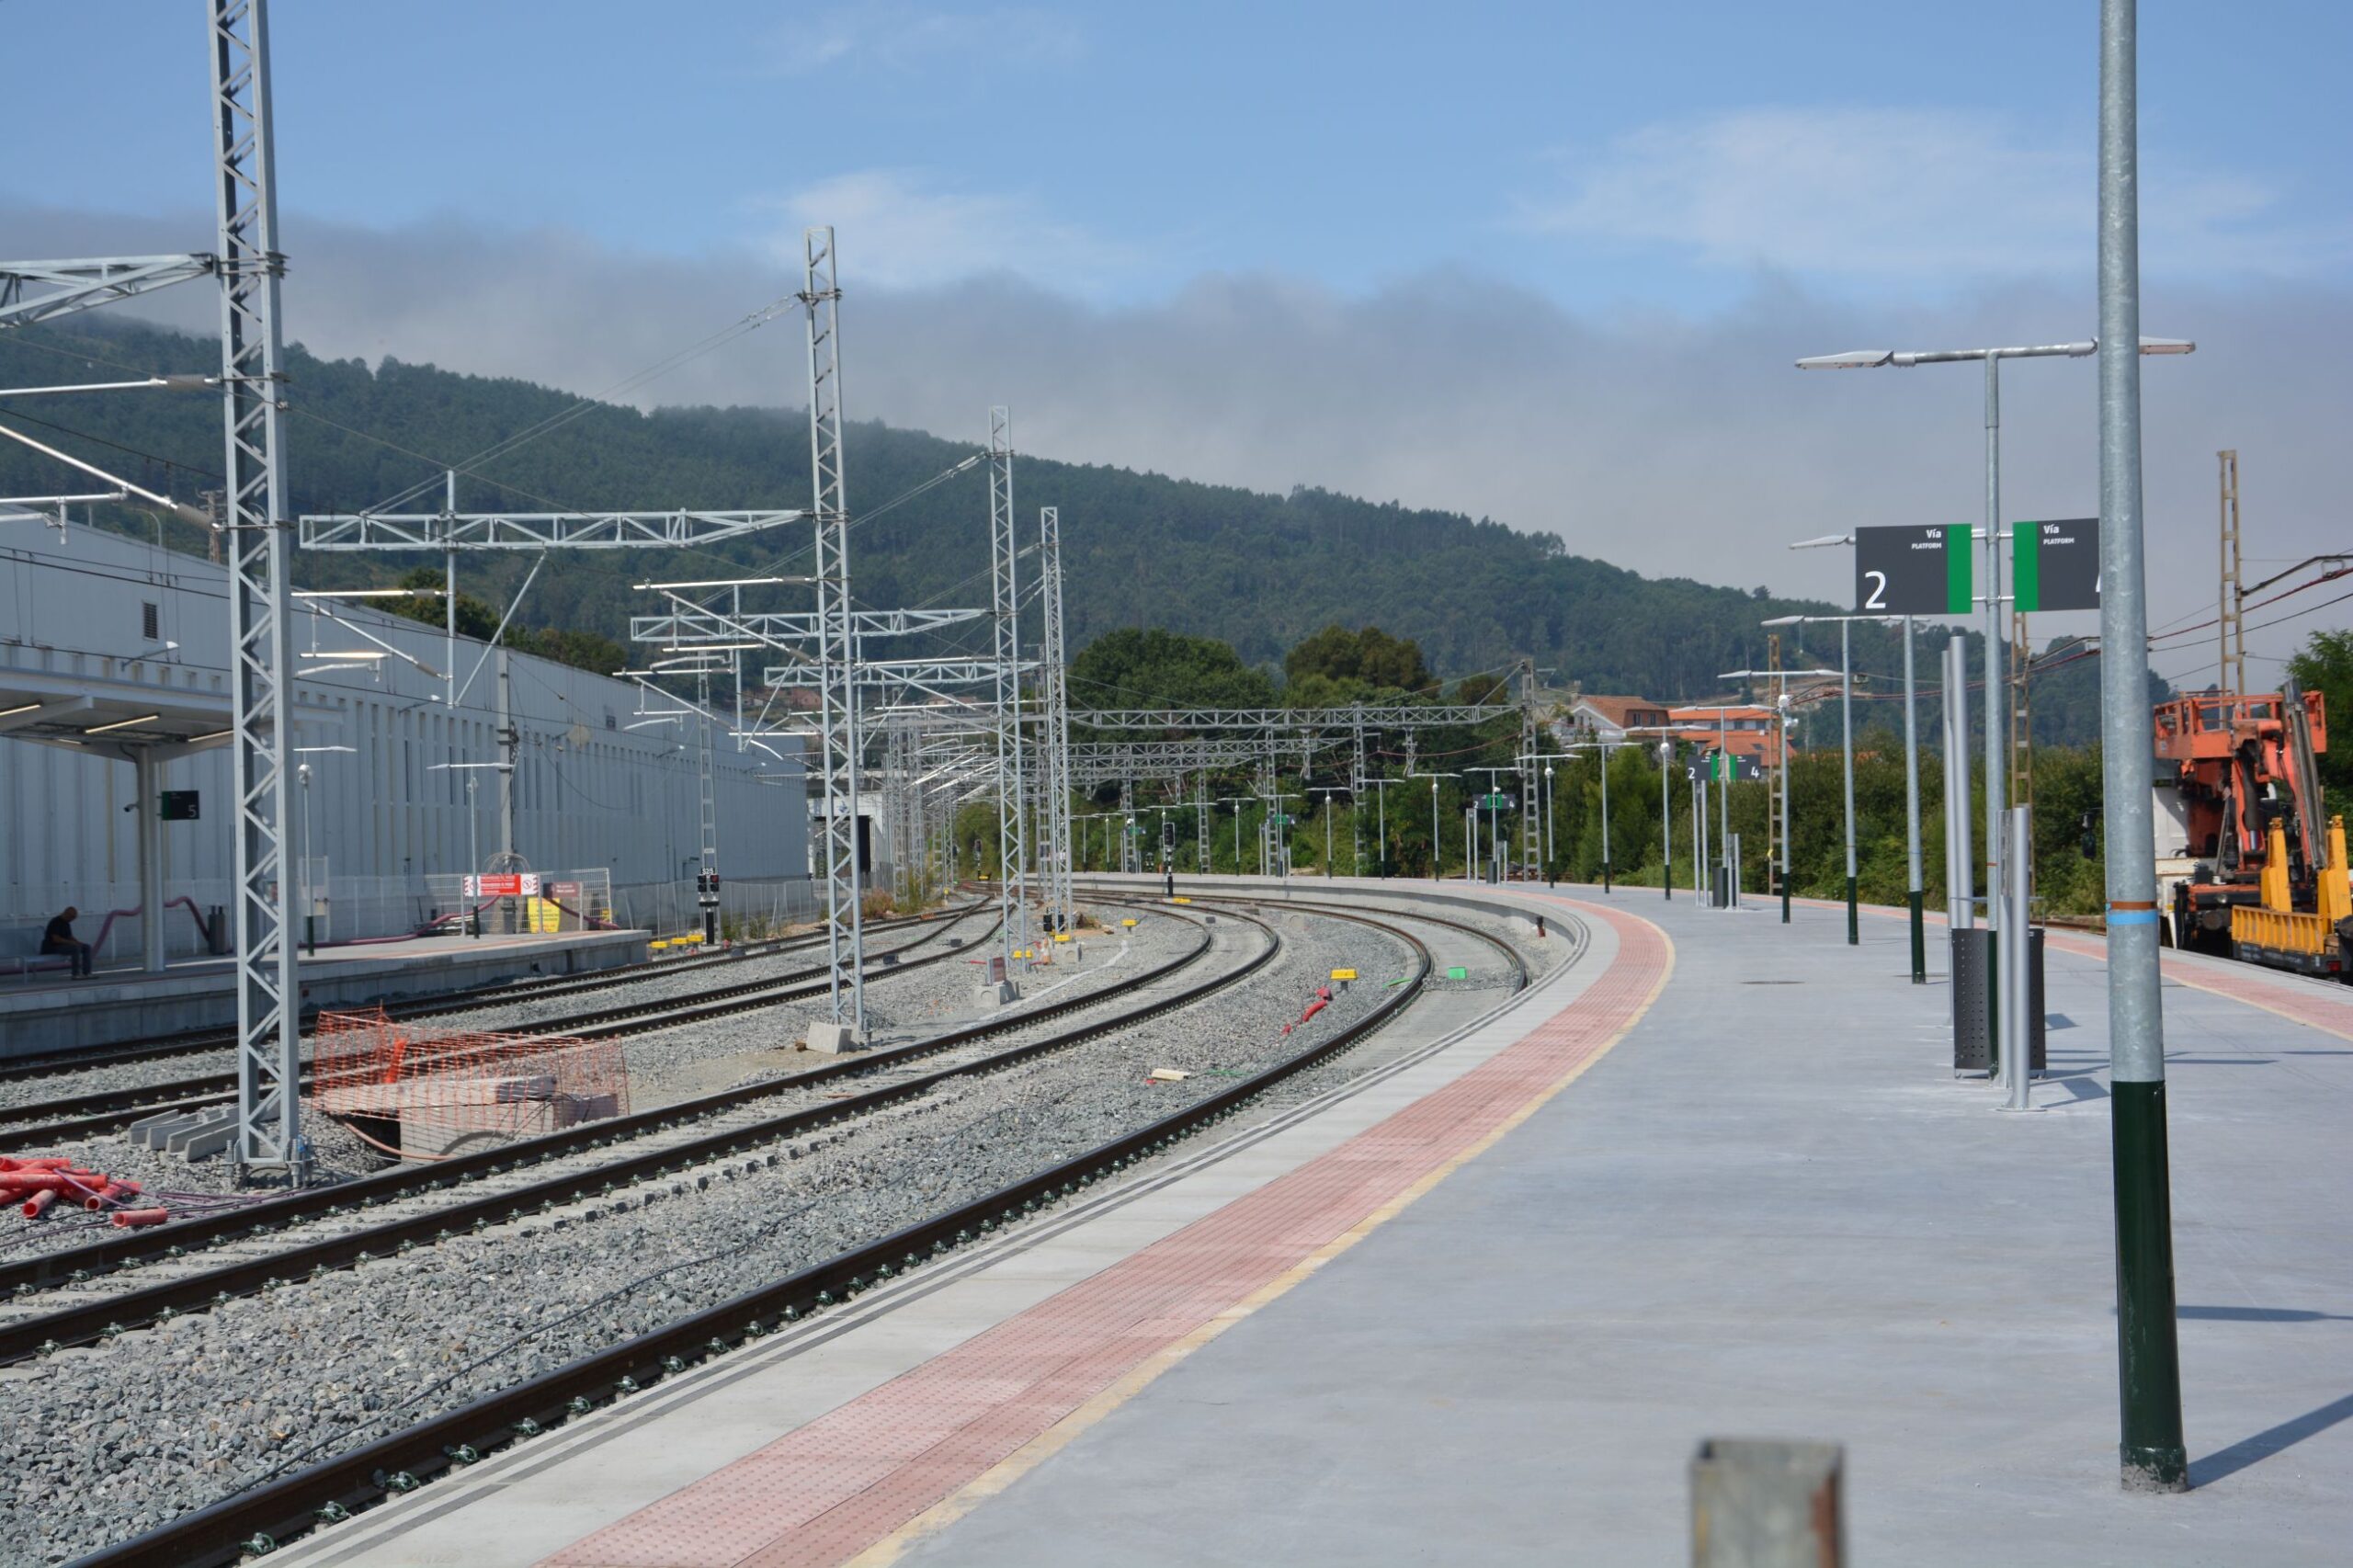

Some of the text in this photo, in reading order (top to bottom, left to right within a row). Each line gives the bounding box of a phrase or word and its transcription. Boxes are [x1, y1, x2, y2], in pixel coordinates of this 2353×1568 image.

[1926, 528, 1942, 539] Vía
[2043, 524, 2060, 534] Vía
[1865, 571, 1886, 608] 2
[1688, 767, 1696, 779] 2
[1750, 766, 1760, 778] 4
[188, 804, 197, 817] 5
[1473, 801, 1479, 809] 2
